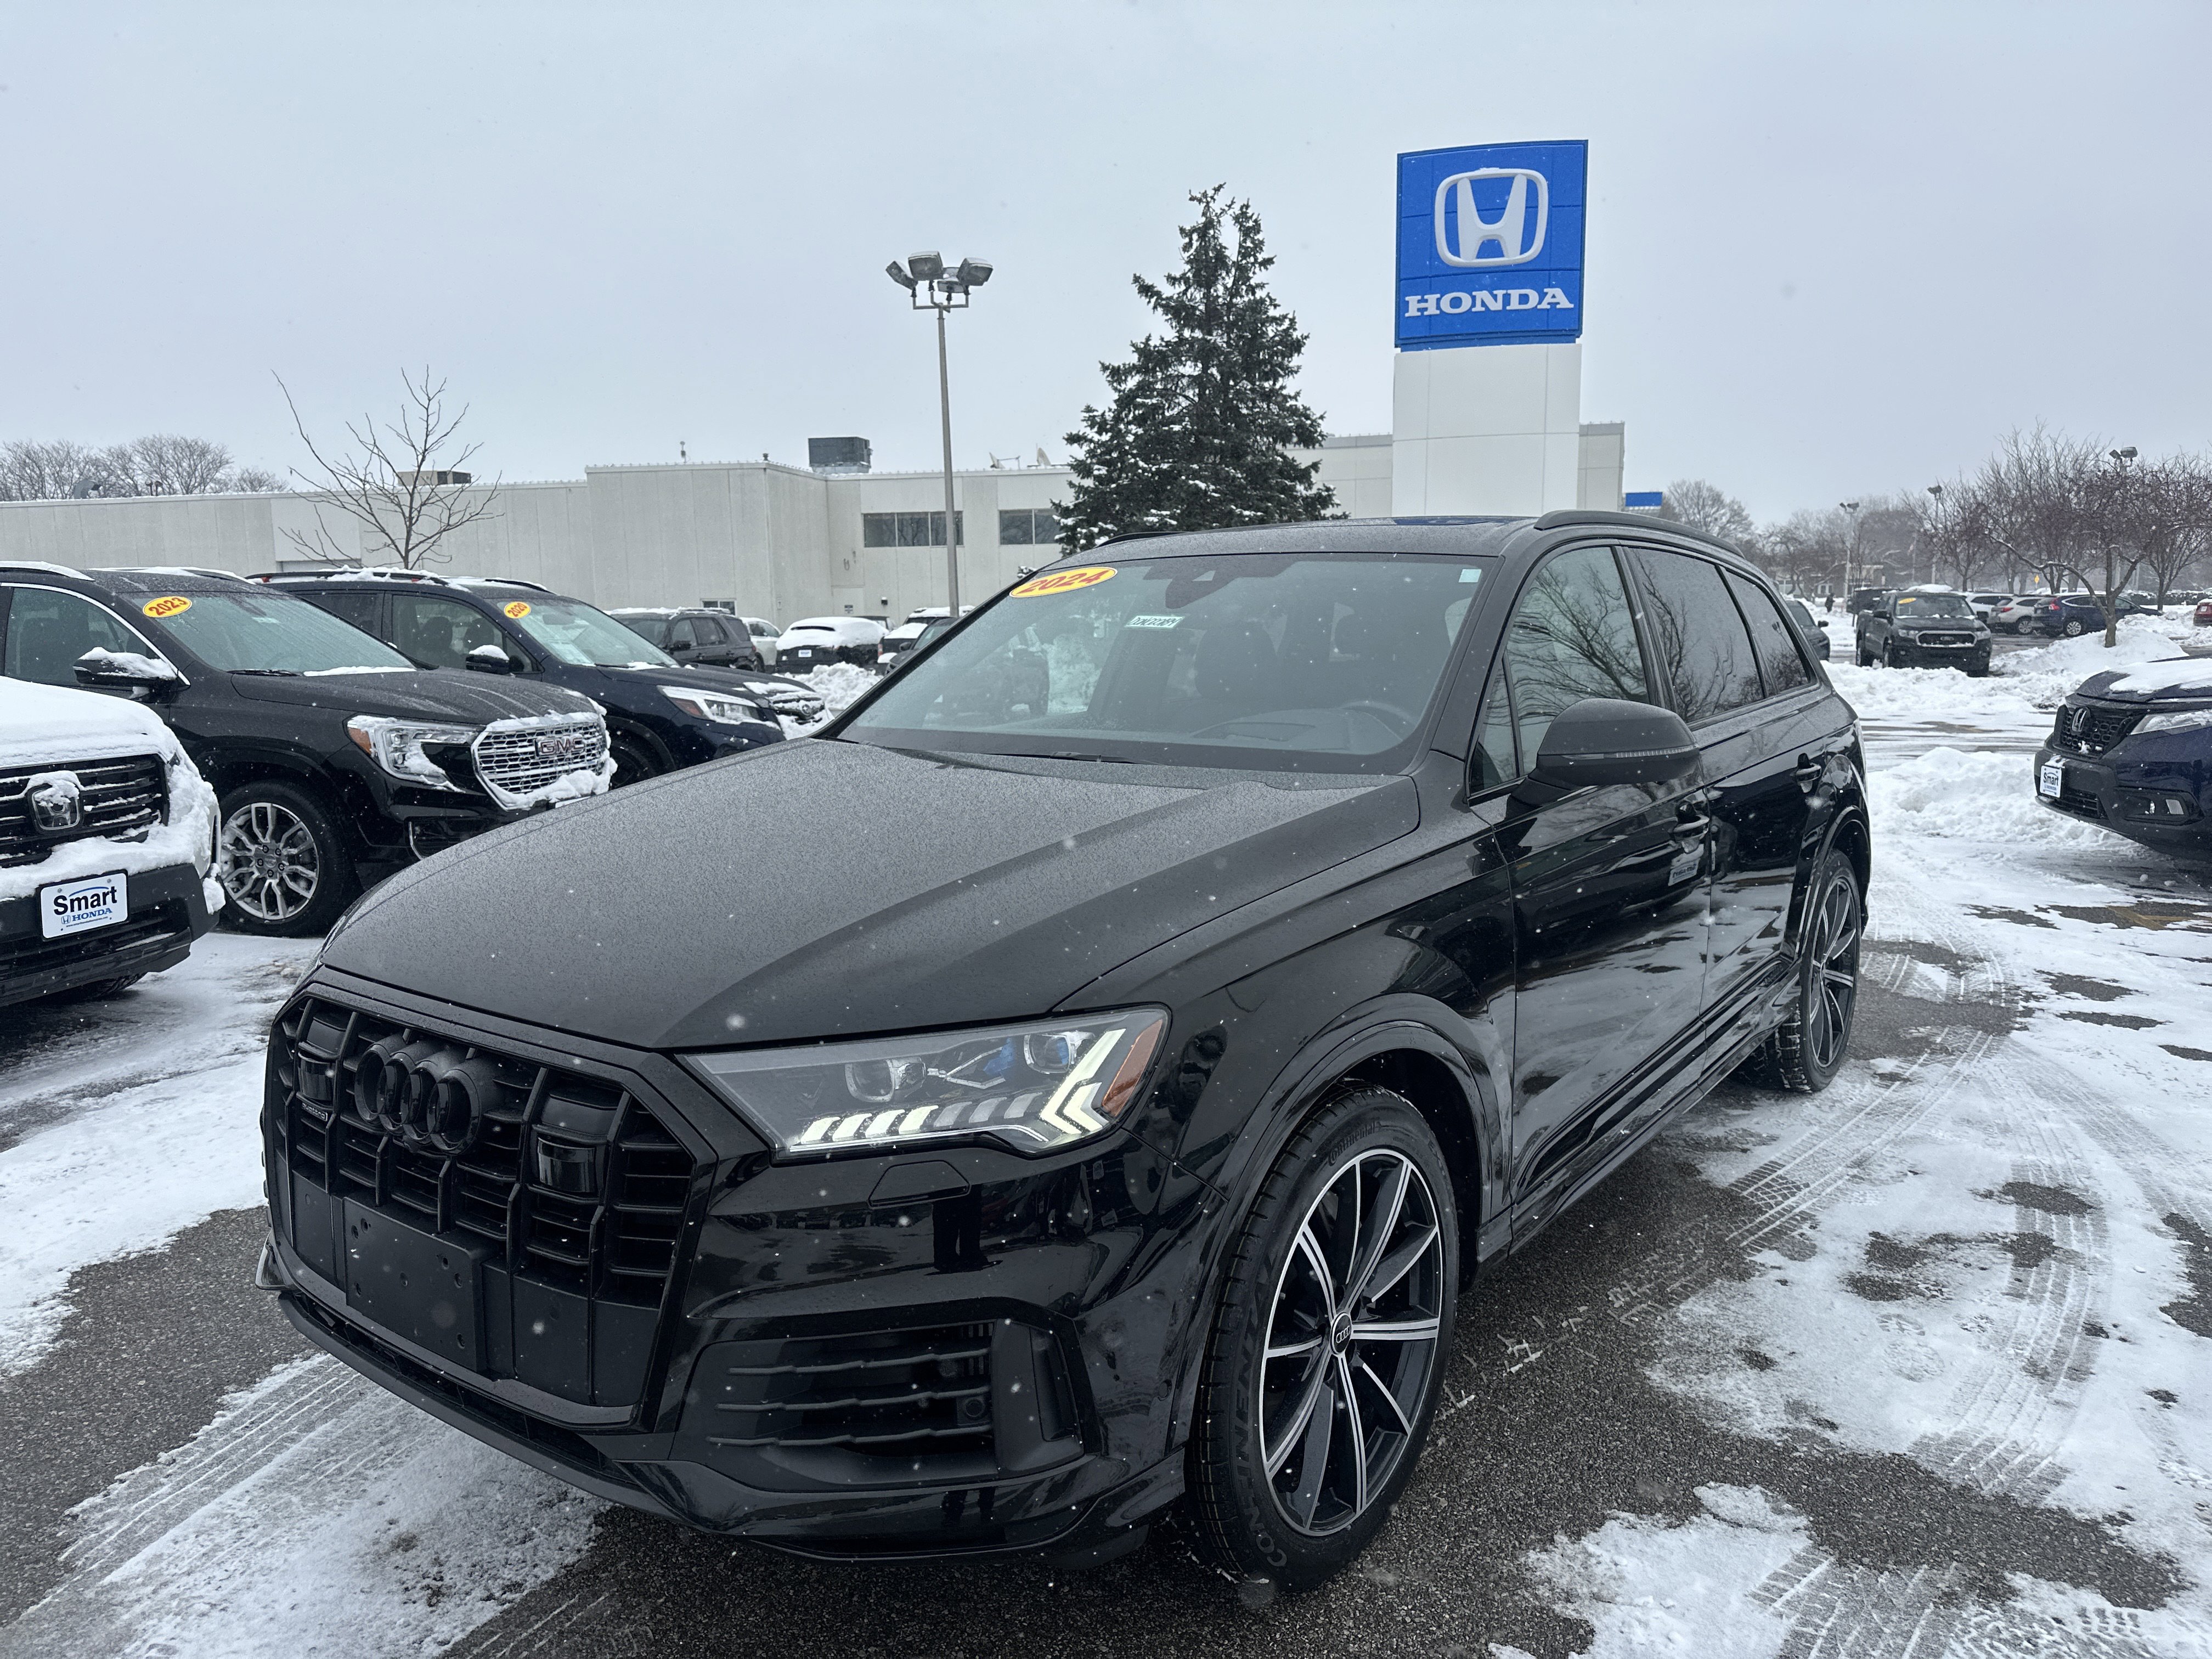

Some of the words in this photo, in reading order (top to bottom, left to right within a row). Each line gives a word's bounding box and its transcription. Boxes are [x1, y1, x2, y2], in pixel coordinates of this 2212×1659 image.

[1404, 287, 1575, 317] HONDA
[1015, 569, 1111, 595] 2024
[148, 597, 188, 616] 2023
[540, 737, 585, 754] GMC
[2043, 772, 2059, 786] Smart
[53, 886, 117, 915] Smart
[72, 907, 113, 922] HONDA
